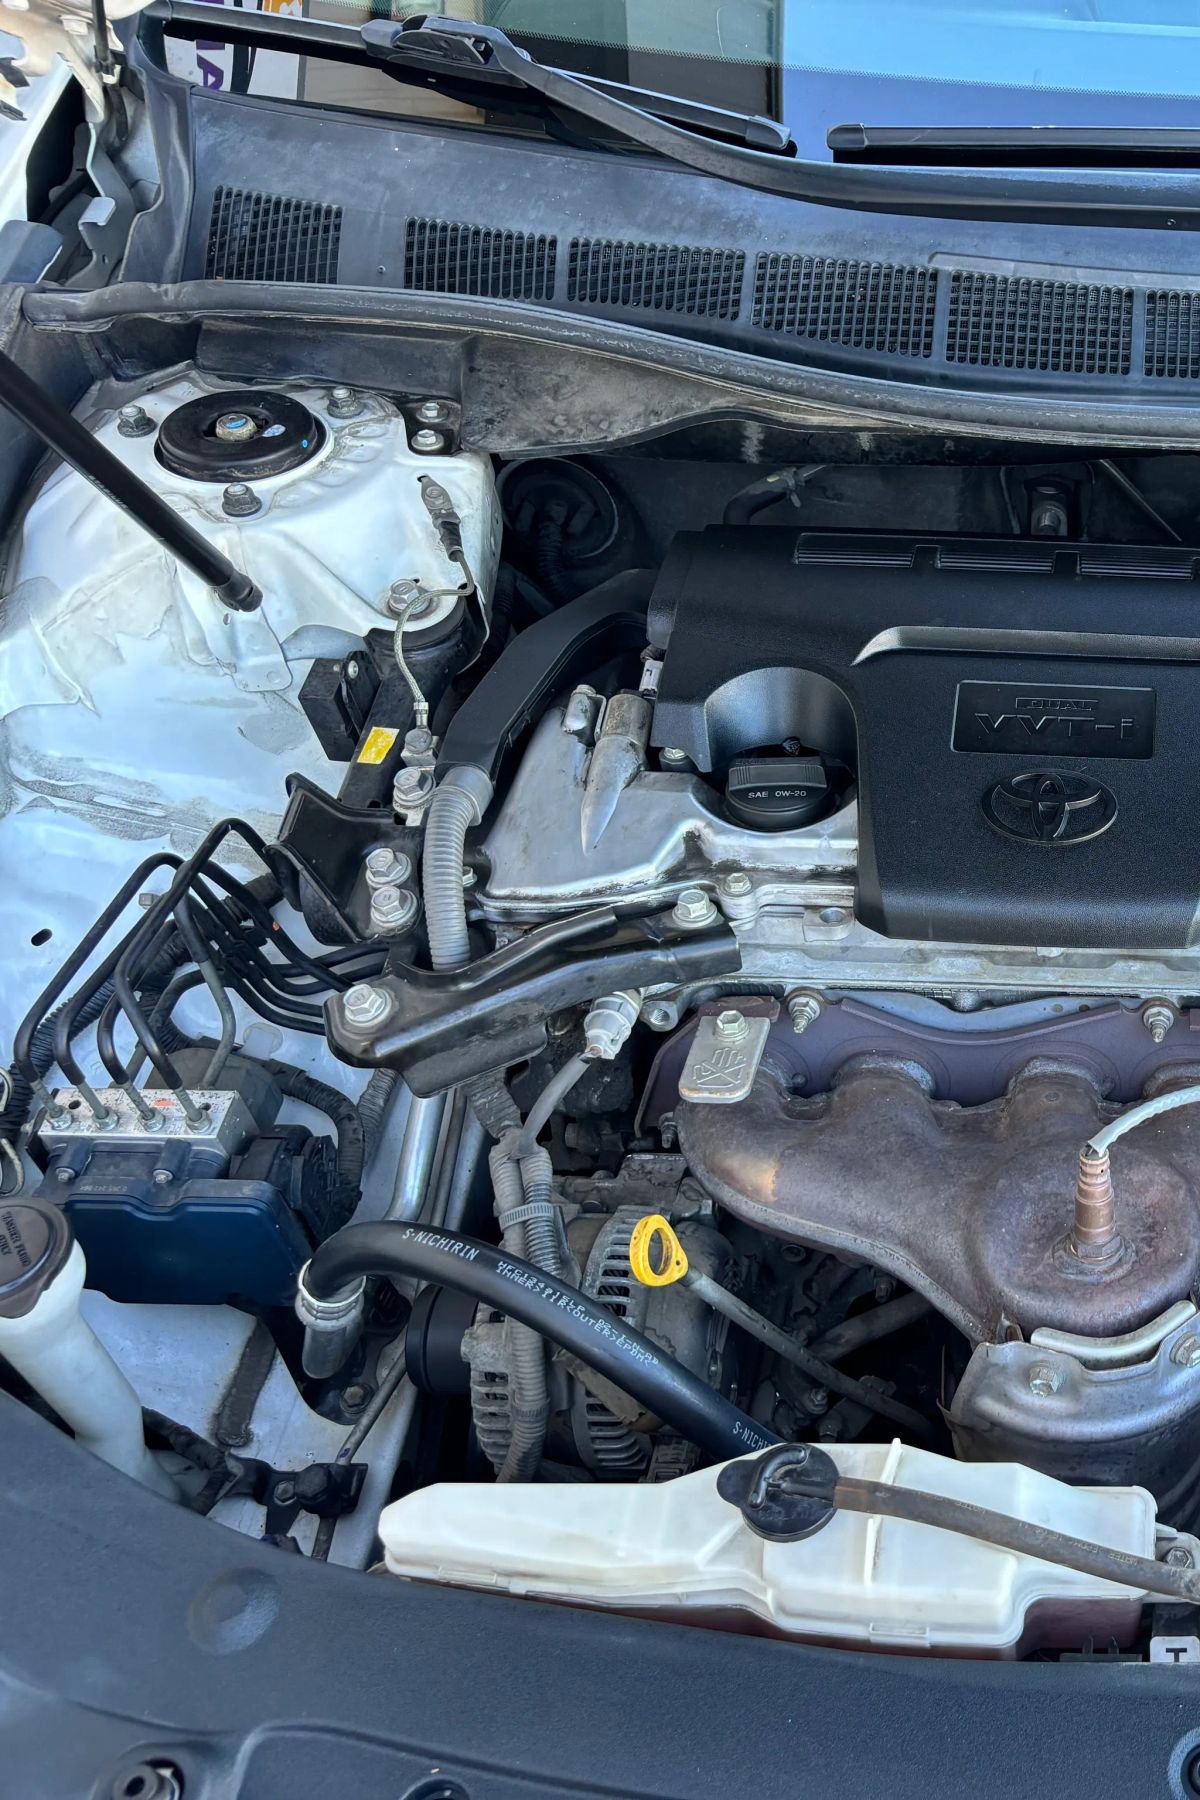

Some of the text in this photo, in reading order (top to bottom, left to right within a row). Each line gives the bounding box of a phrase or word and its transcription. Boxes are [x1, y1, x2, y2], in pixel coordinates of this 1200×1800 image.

[974, 712, 1135, 739] VVT-i
[748, 790, 807, 798] SAE 0W-20
[1165, 1647, 1188, 1663] T
